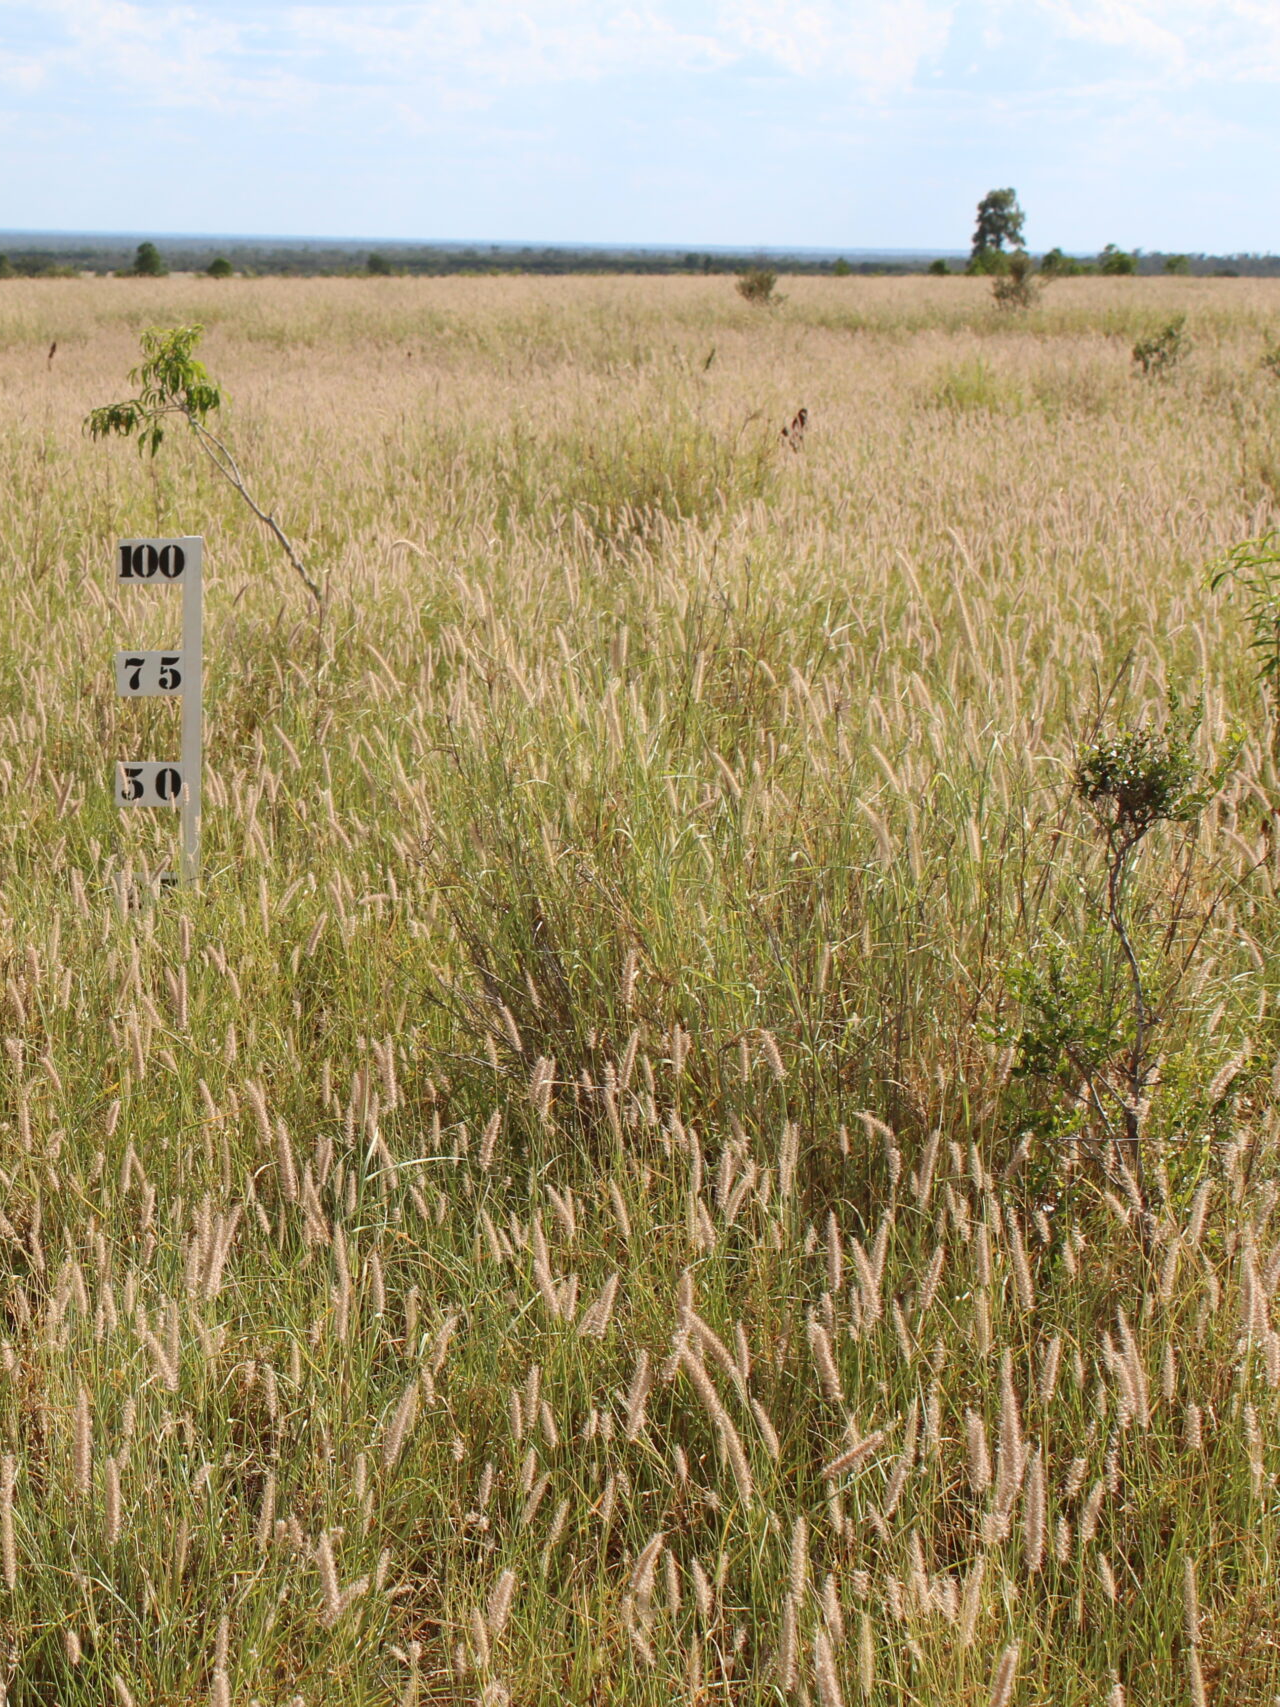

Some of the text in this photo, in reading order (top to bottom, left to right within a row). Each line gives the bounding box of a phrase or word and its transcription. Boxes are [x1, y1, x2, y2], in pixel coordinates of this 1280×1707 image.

[119, 544, 185, 578] 100
[124, 656, 182, 690] 75
[121, 767, 182, 801] 50
